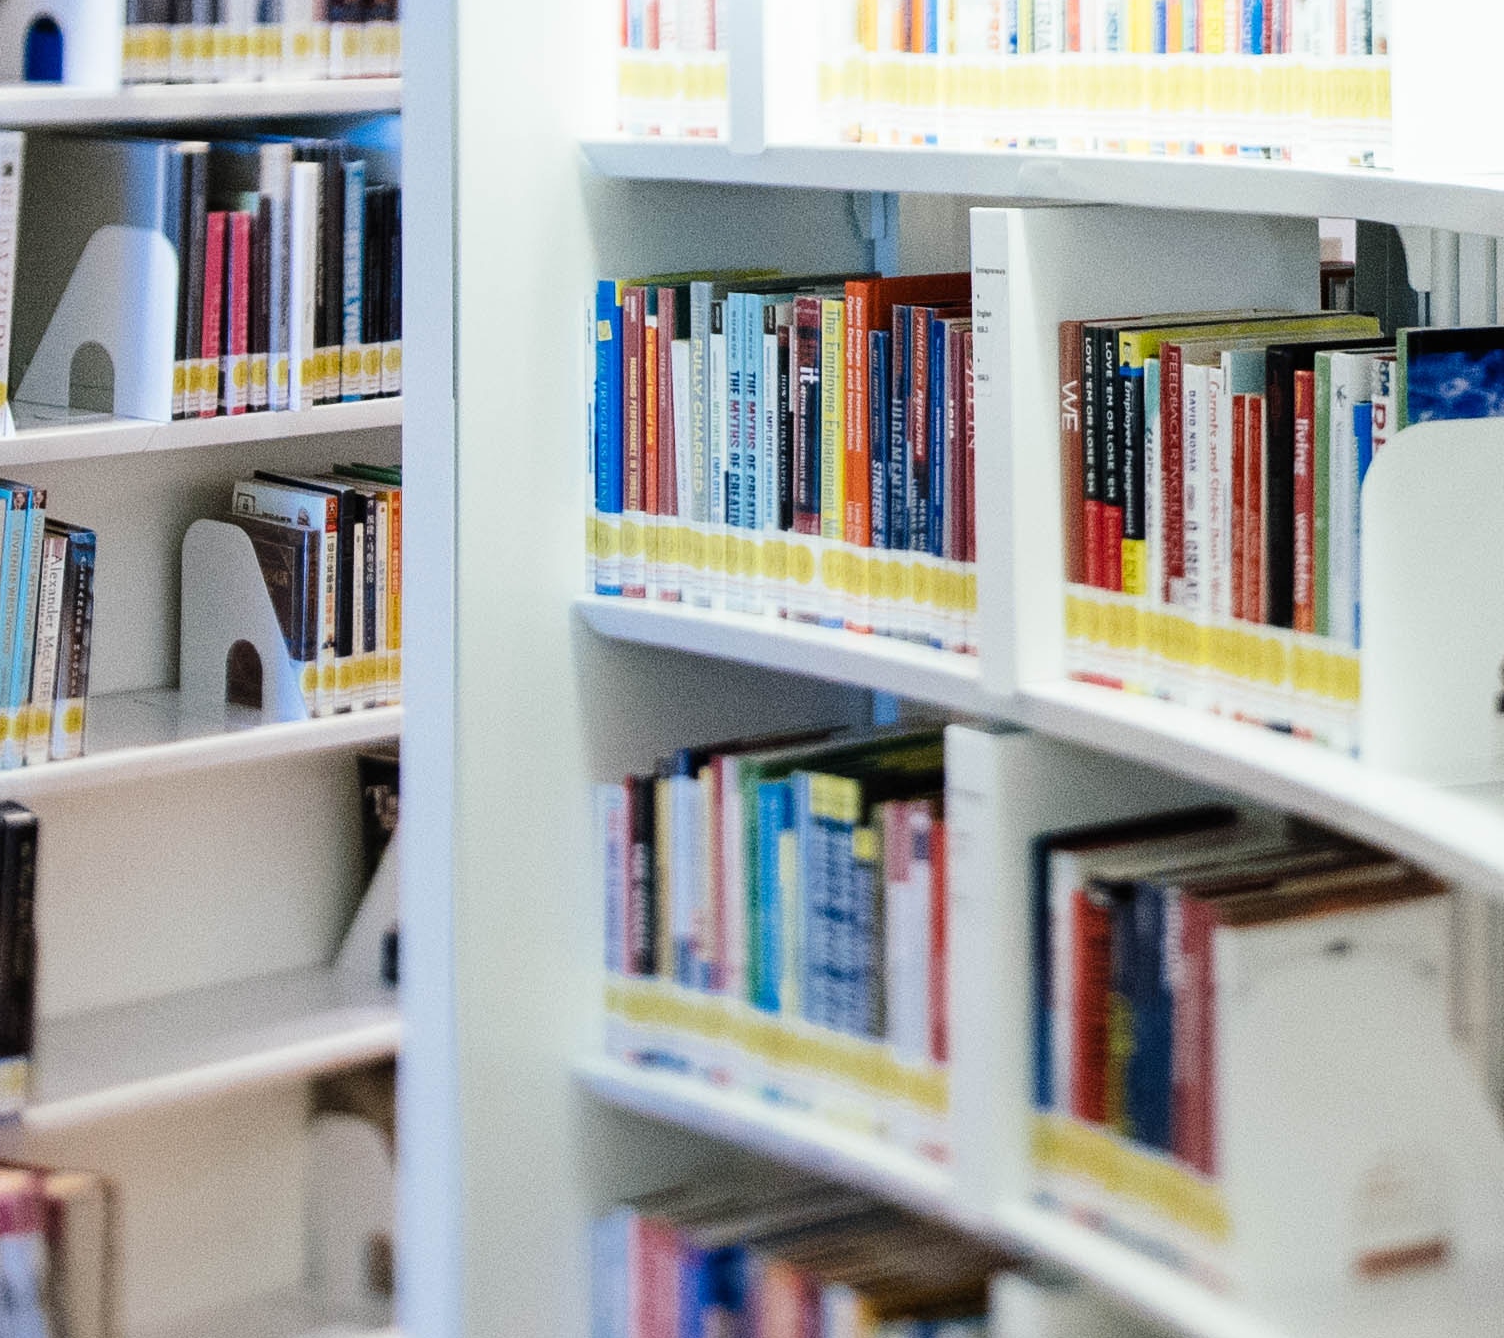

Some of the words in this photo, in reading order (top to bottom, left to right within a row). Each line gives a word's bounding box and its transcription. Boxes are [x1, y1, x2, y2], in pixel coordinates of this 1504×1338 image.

[825, 308, 841, 335] The
[844, 295, 854, 325] Open
[853, 296, 863, 326] Open
[844, 326, 854, 367] Design
[853, 328, 863, 368] Design
[916, 315, 924, 369] PRIMED
[1084, 336, 1094, 375] LOVE
[1104, 341, 1114, 379] LOVE
[692, 338, 704, 396] FULLY
[730, 370, 741, 394] THE
[747, 371, 757, 396] THE
[821, 340, 840, 413] Employee
[845, 368, 854, 388] and
[854, 369, 863, 389] and
[1060, 379, 1079, 432] WE
[1084, 377, 1095, 403] 'EM
[1105, 381, 1115, 407] 'EM
[1168, 351, 1180, 444] FEEDBACK
[1188, 389, 1197, 427] DAVID
[730, 398, 741, 448] MYTHS
[747, 400, 757, 450] MYTHS
[845, 389, 854, 451] Innovation
[854, 390, 863, 453] Innovation
[915, 388, 924, 456] PERFORM
[1085, 405, 1095, 427] OR
[1105, 409, 1115, 431] OR
[1123, 380, 1135, 447] Employee
[692, 400, 704, 493] CHARGED
[765, 410, 773, 458] EMPLOYEE
[1086, 429, 1095, 466] LOSE
[1106, 434, 1116, 470] LOSE
[1188, 431, 1197, 473] NOVAK
[730, 452, 741, 469] OF
[747, 453, 757, 470] OF
[821, 420, 840, 512] Engagement
[711, 456, 721, 508] EMPLOYEES
[1106, 472, 1116, 498] 'EM
[44, 553, 64, 630] Alexander
